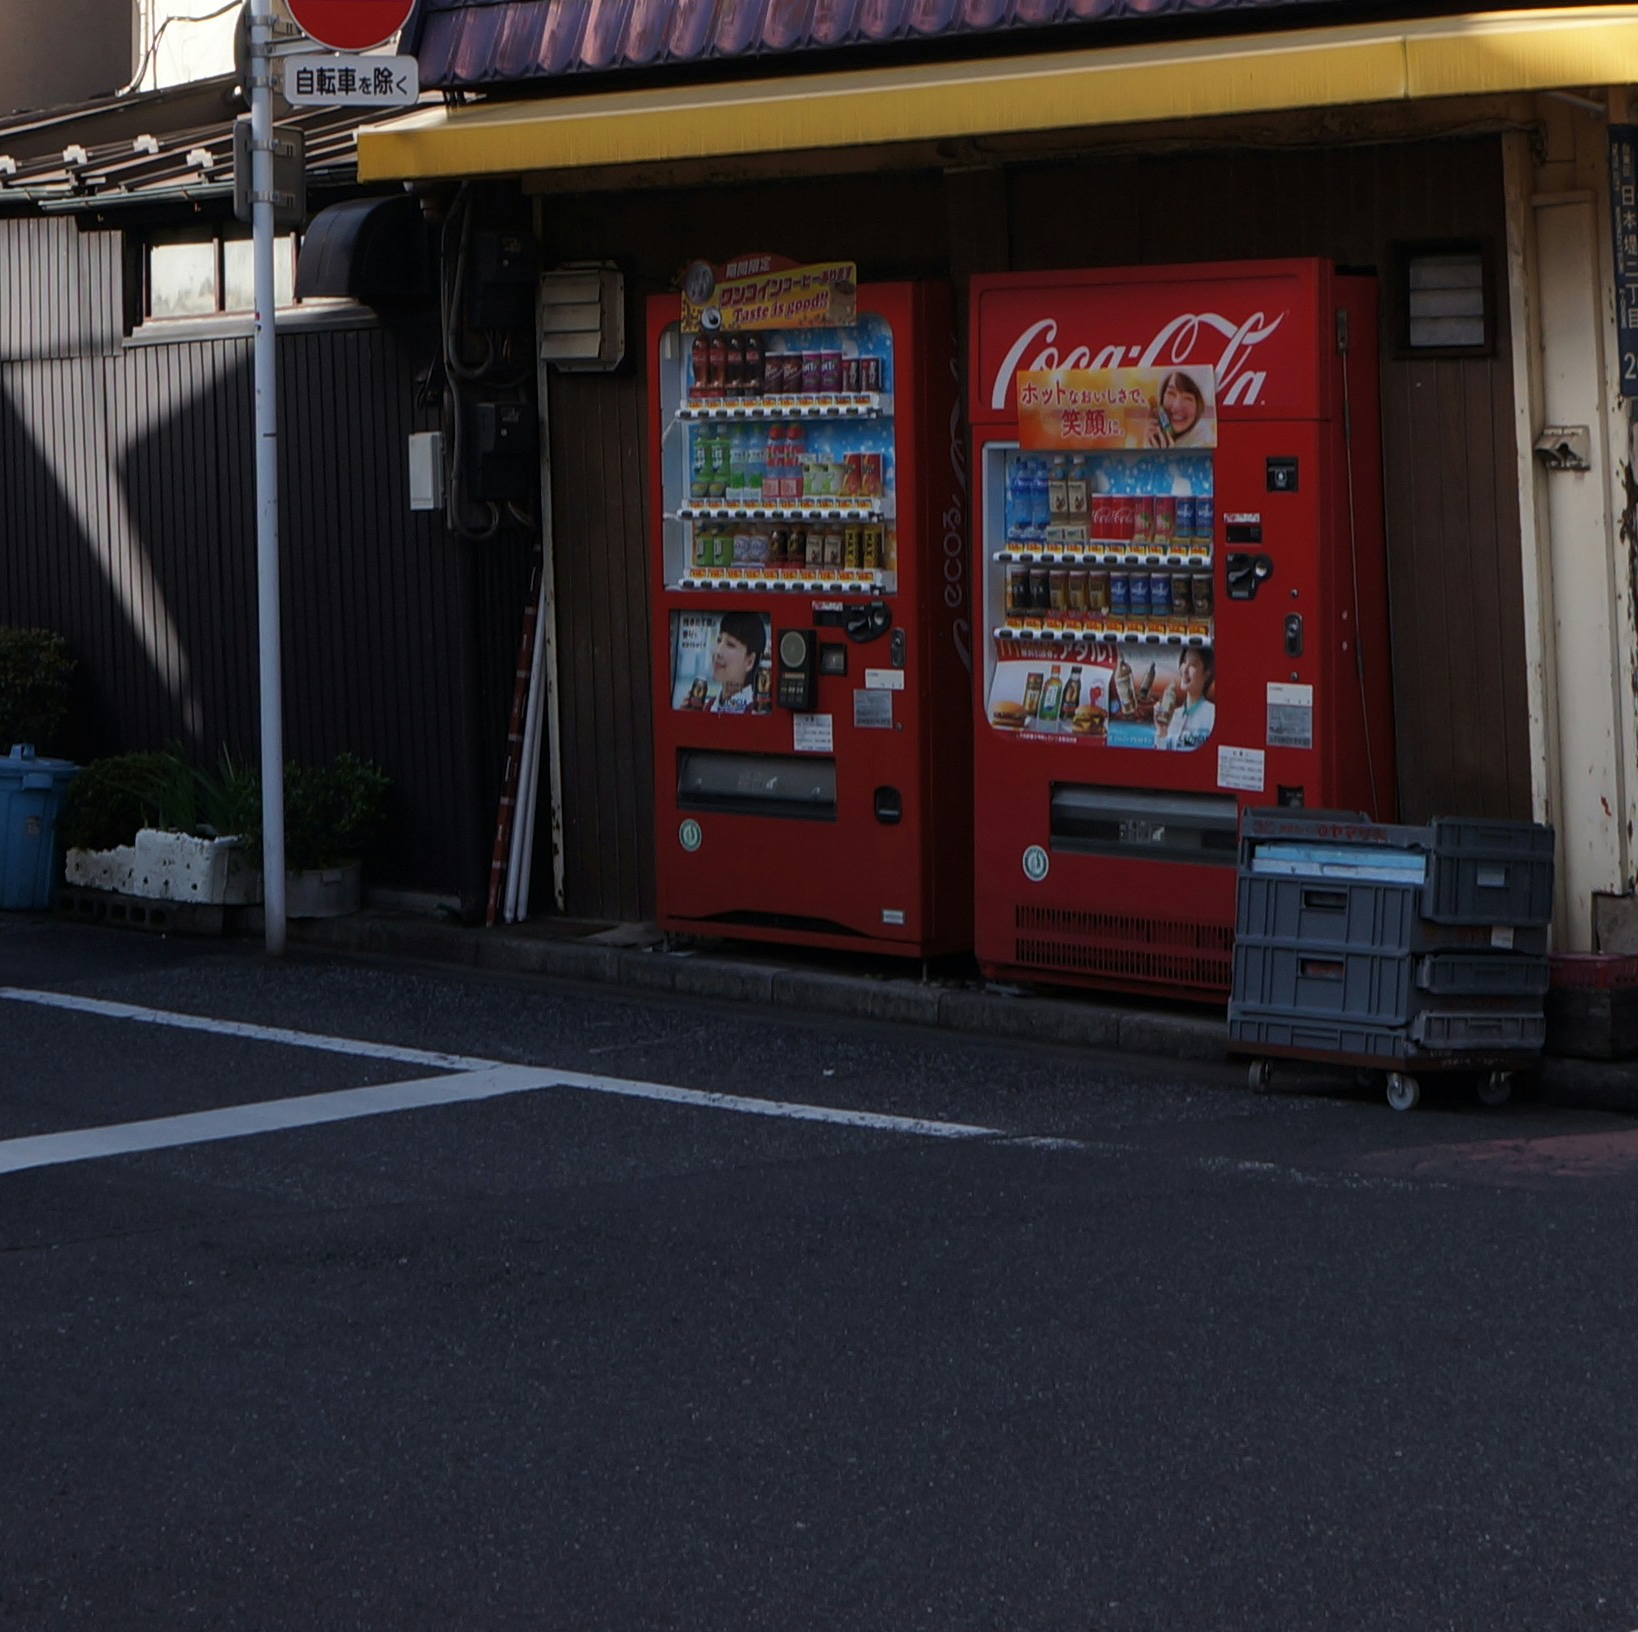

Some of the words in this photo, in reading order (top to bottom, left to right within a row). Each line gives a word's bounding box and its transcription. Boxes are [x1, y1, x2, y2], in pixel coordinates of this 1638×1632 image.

[295, 66, 408, 96] 自転車を除く
[725, 257, 772, 278] 期間限定
[733, 305, 769, 324] Taste
[772, 301, 785, 317] is
[786, 291, 829, 319] good!!
[991, 311, 1288, 410] C-Cla
[1021, 381, 1146, 406] ホットなおいしさで、
[1061, 408, 1126, 438] 笑顔に。
